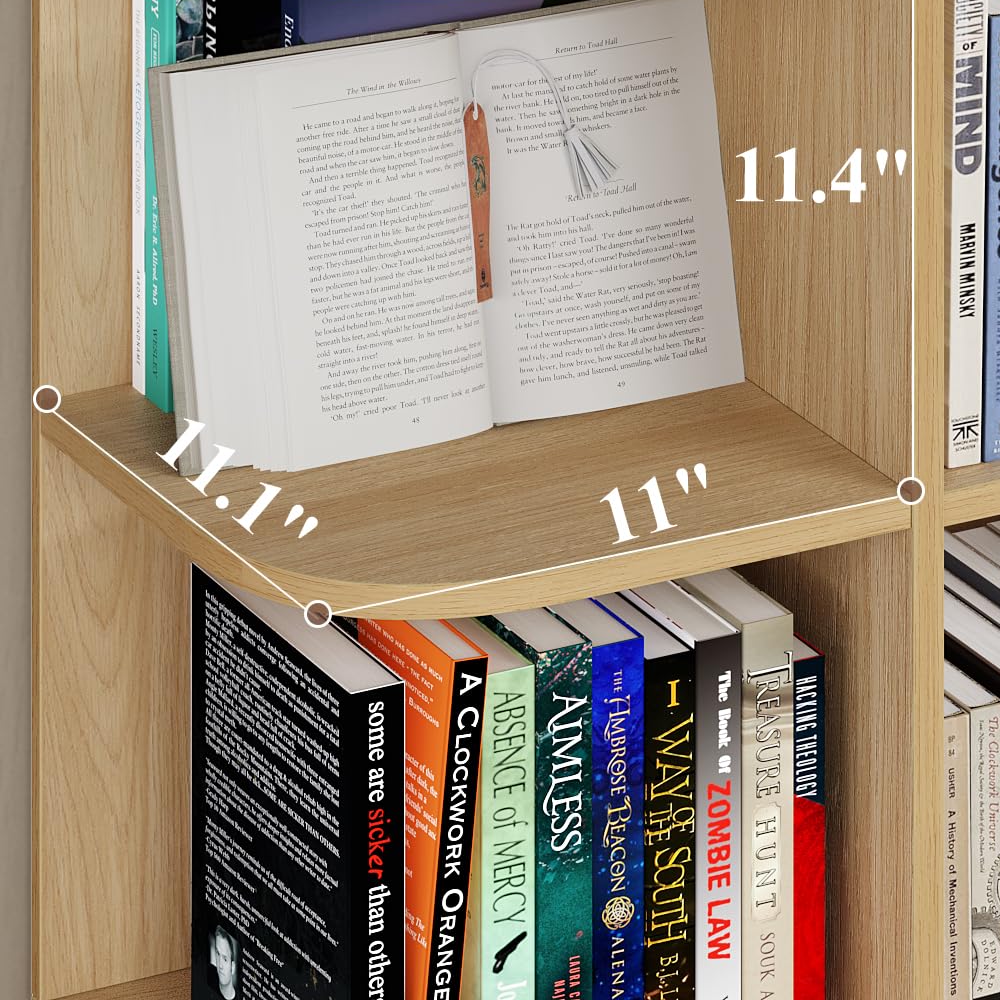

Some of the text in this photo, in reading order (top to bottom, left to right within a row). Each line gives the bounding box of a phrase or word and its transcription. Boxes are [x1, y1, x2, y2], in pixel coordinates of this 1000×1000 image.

[556, 45, 578, 54] Return
[588, 41, 603, 49] Toad
[605, 38, 617, 46] Hall
[717, 669, 732, 702] The
[719, 708, 732, 748] Book
[368, 700, 391, 1000] some are sicker than other
[706, 782, 731, 892] ZOMBIE
[707, 897, 731, 960] LAW
